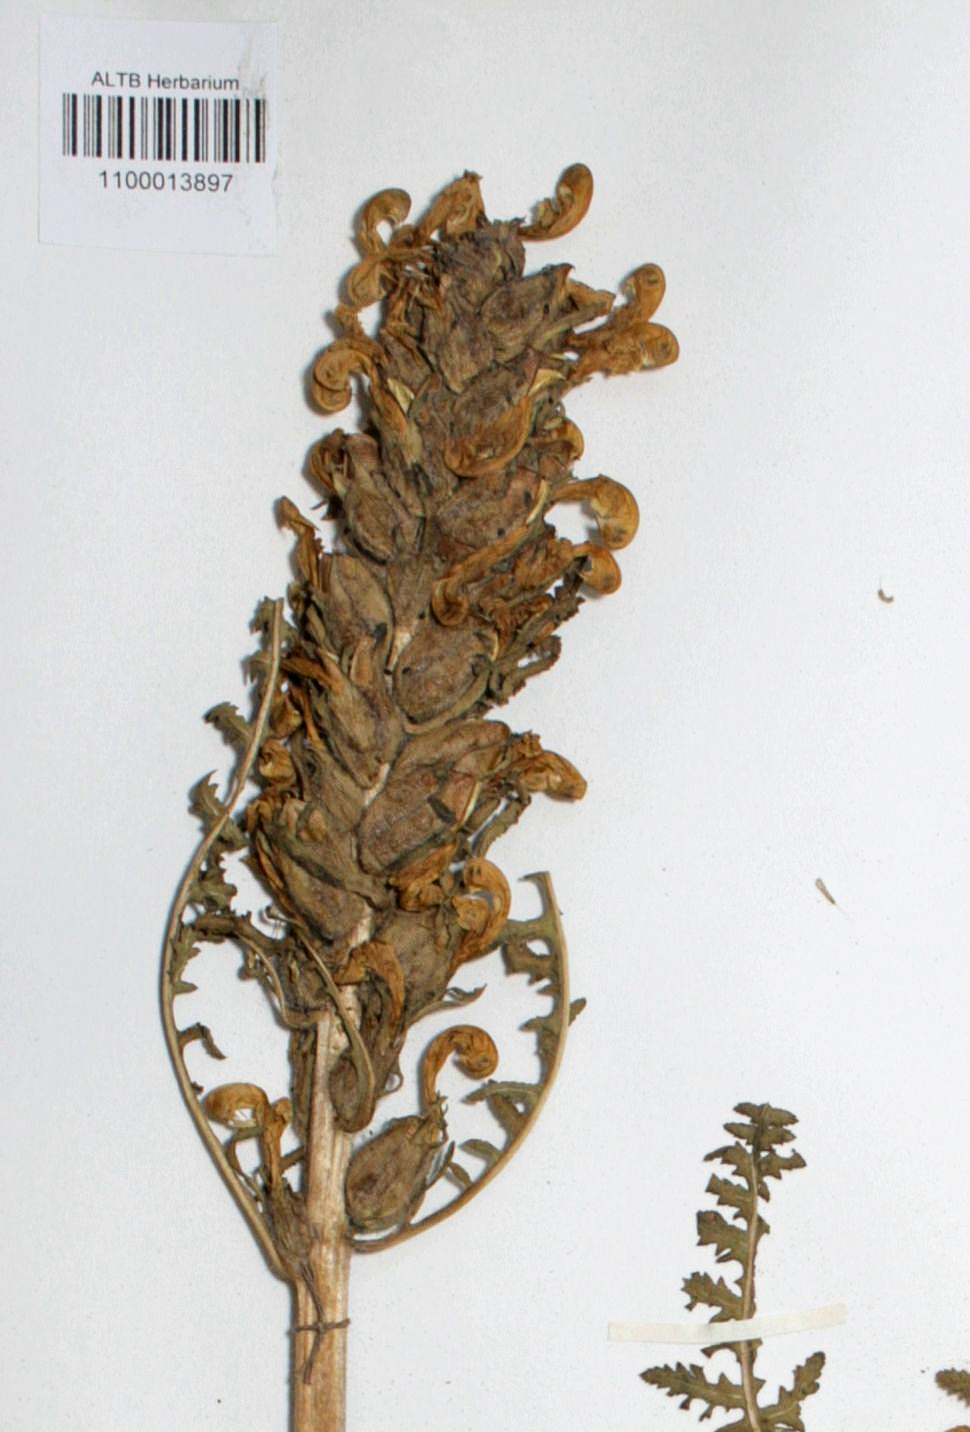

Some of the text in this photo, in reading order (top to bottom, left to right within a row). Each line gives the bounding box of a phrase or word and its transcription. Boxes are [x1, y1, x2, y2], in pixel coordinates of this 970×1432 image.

[91, 71, 239, 90] ALTB Herbarium
[100, 170, 233, 192] 1100013897
